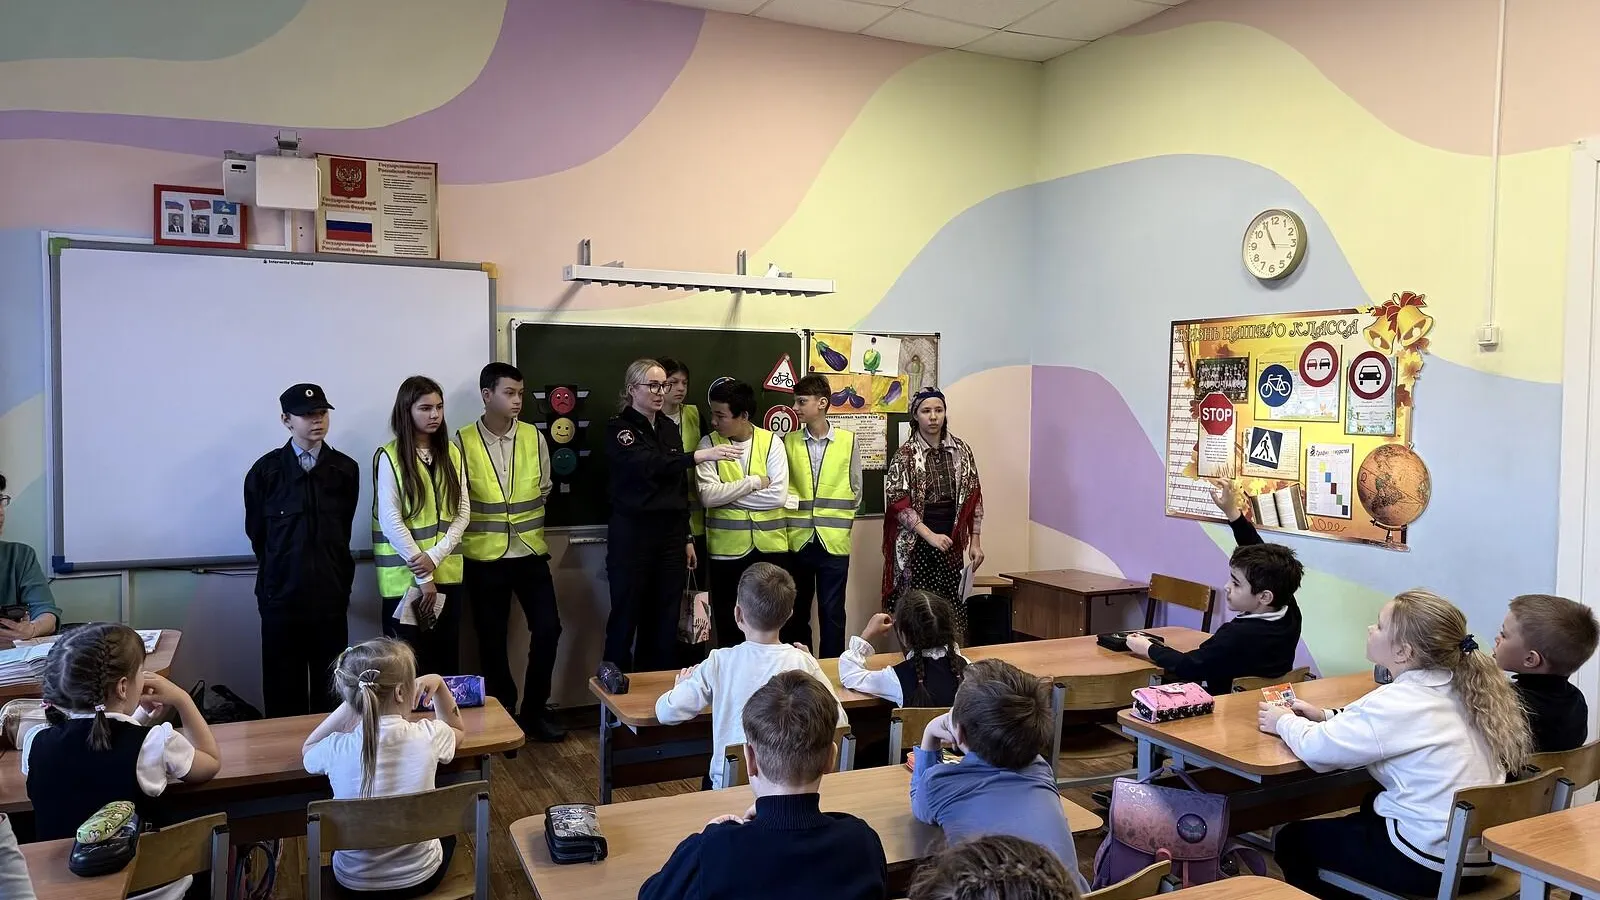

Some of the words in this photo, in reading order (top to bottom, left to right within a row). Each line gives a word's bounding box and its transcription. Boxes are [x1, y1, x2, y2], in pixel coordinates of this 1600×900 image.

[1271, 216, 1280, 225] 12
[1283, 219, 1287, 228] 1
[1255, 230, 1264, 239] 10
[1288, 227, 1294, 236] 2
[1251, 242, 1257, 251] 9
[1290, 239, 1296, 247] 3
[1253, 254, 1260, 262] 8
[1286, 251, 1292, 260] 4
[1260, 261, 1266, 270] 7
[1269, 265, 1275, 273] 6
[1279, 260, 1285, 269] 5
[1289, 318, 1359, 340] КЛАССА
[1202, 407, 1232, 422] STOP
[770, 416, 790, 432] 60
